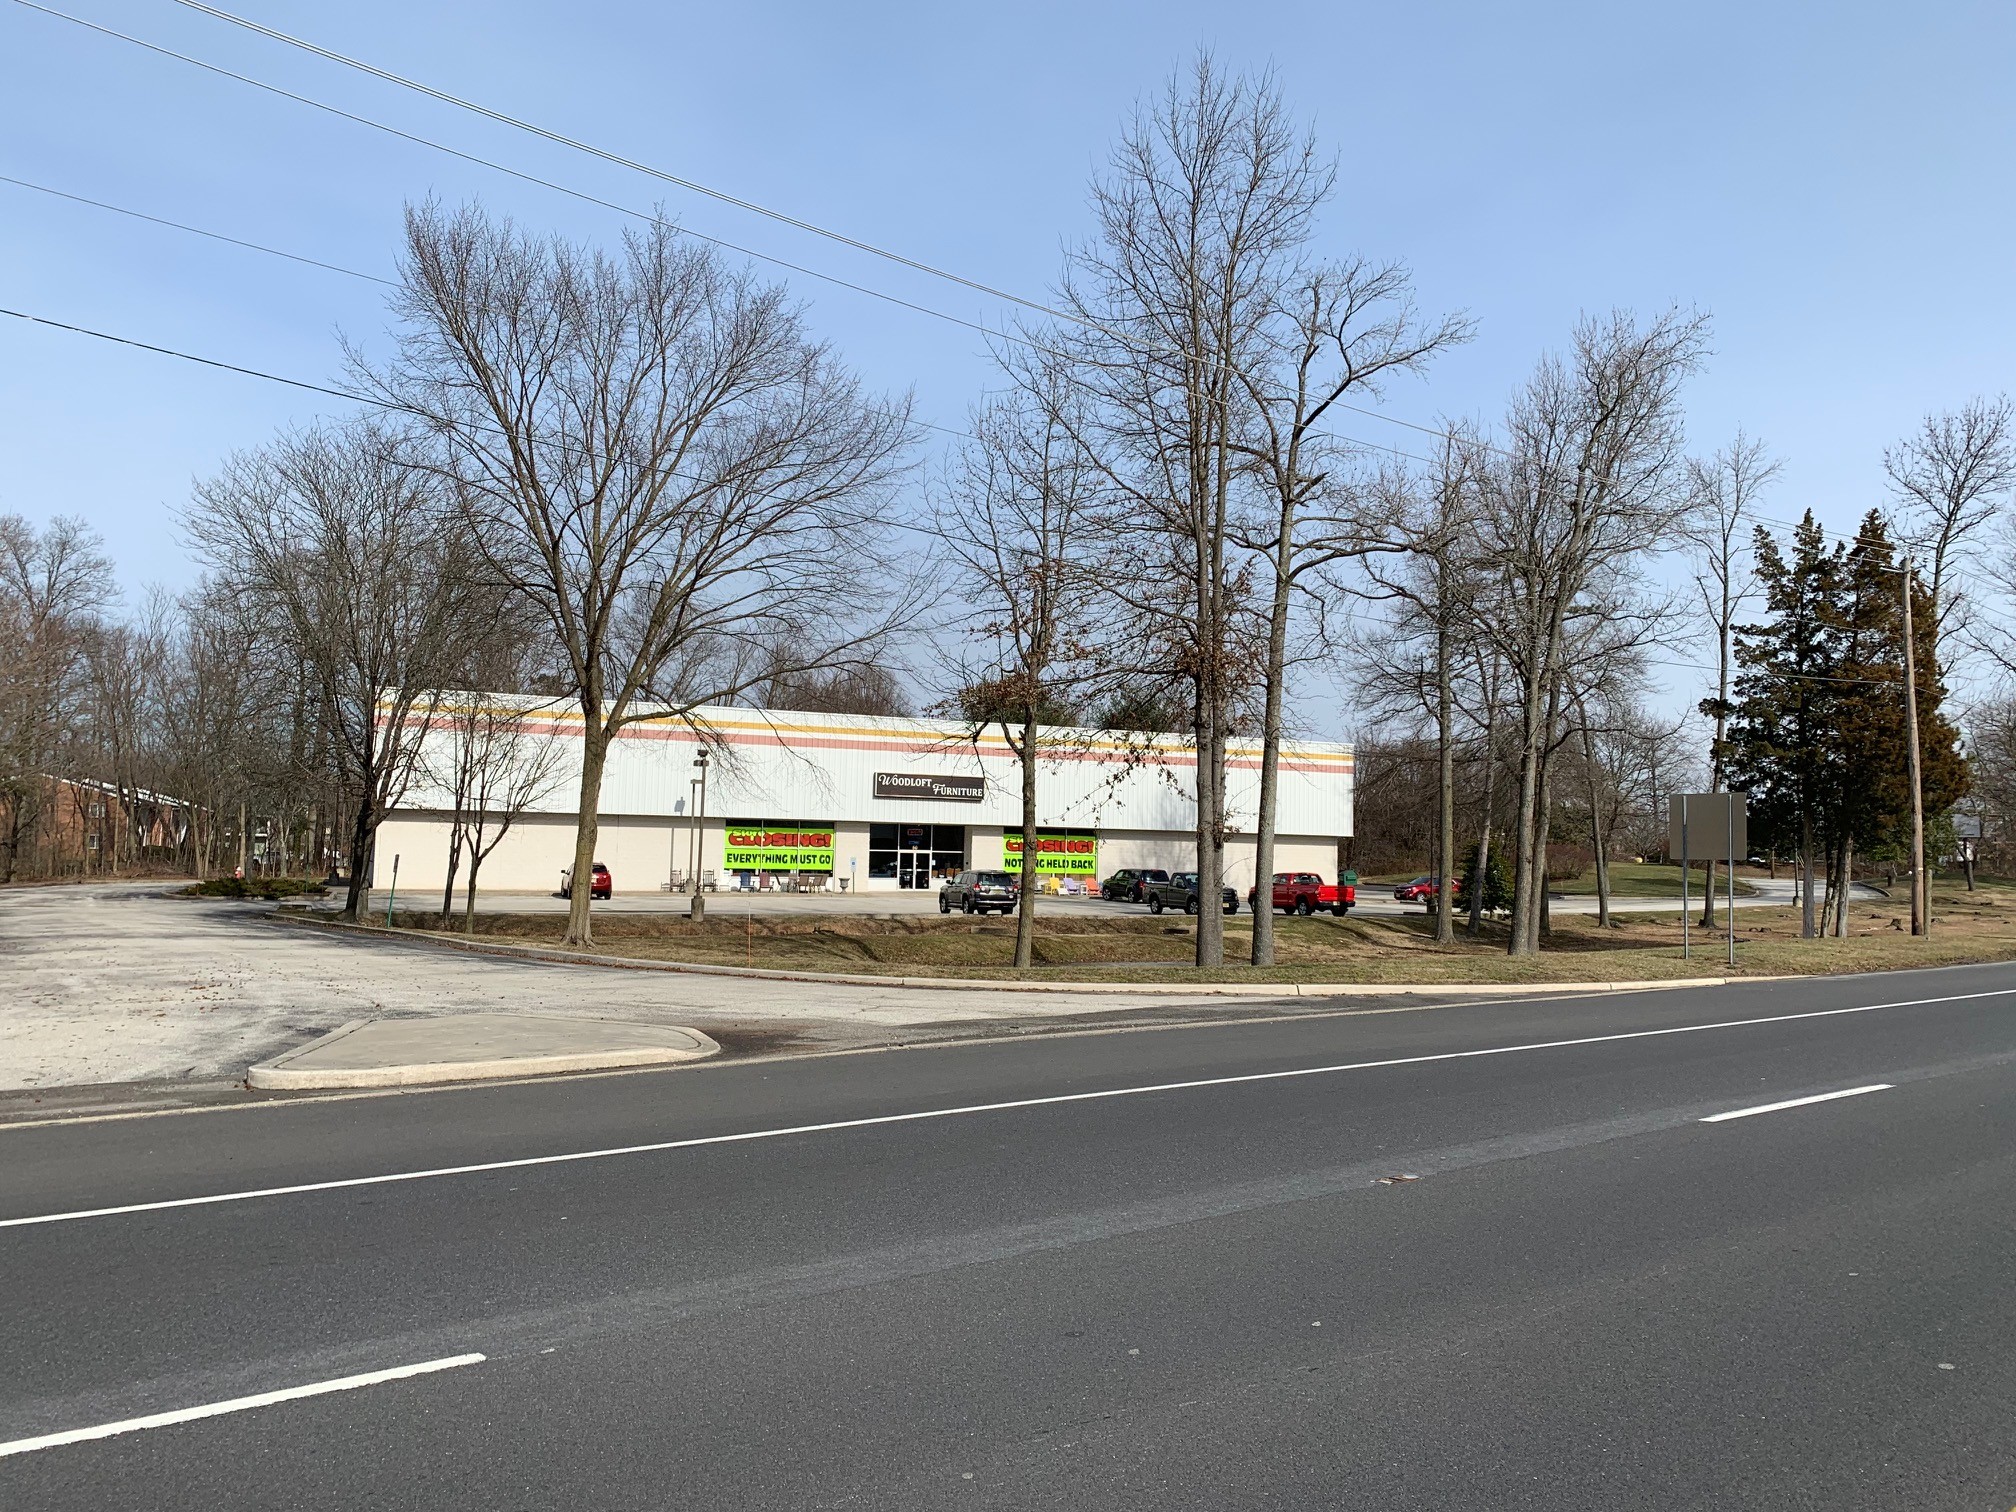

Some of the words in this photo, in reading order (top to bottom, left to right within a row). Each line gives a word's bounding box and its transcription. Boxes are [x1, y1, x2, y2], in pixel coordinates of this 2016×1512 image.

[878, 774, 932, 787] WOODLOFT
[932, 783, 983, 797] FURNITURE
[728, 831, 832, 848] CLOSING!
[726, 853, 788, 864] EVERYTHING
[790, 854, 817, 864] MUST
[819, 854, 831, 864] GO
[1004, 858, 1045, 868] NOTNG
[1046, 859, 1069, 868] HELD
[1071, 860, 1094, 869] BACK
